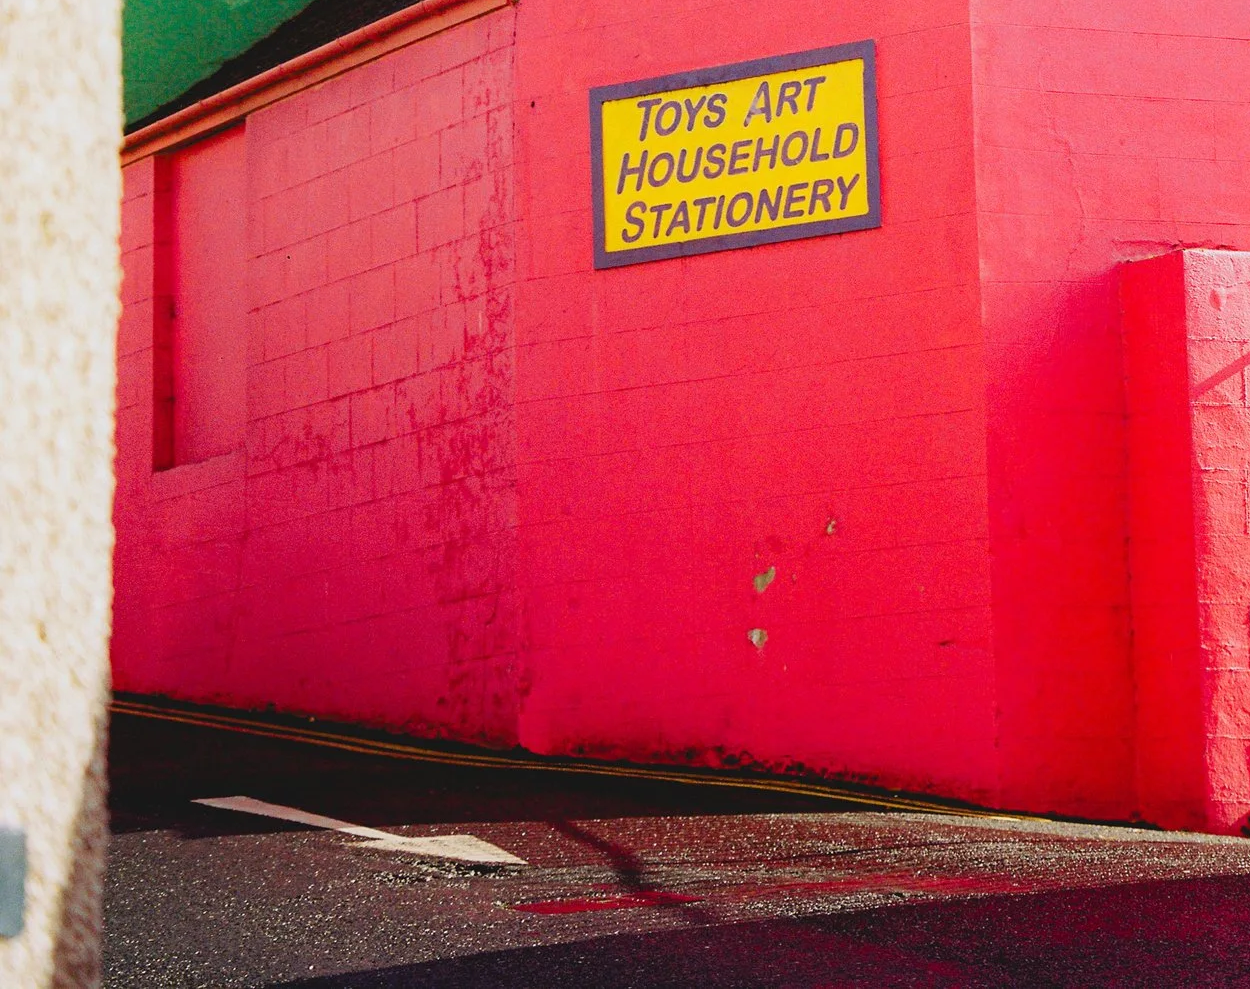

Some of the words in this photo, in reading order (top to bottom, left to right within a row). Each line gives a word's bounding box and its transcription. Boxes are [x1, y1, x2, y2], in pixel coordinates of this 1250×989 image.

[637, 93, 728, 142] TOYS
[743, 76, 827, 128] ART
[616, 122, 860, 195] HOUSEHOLD
[621, 173, 861, 244] STATIONERY
